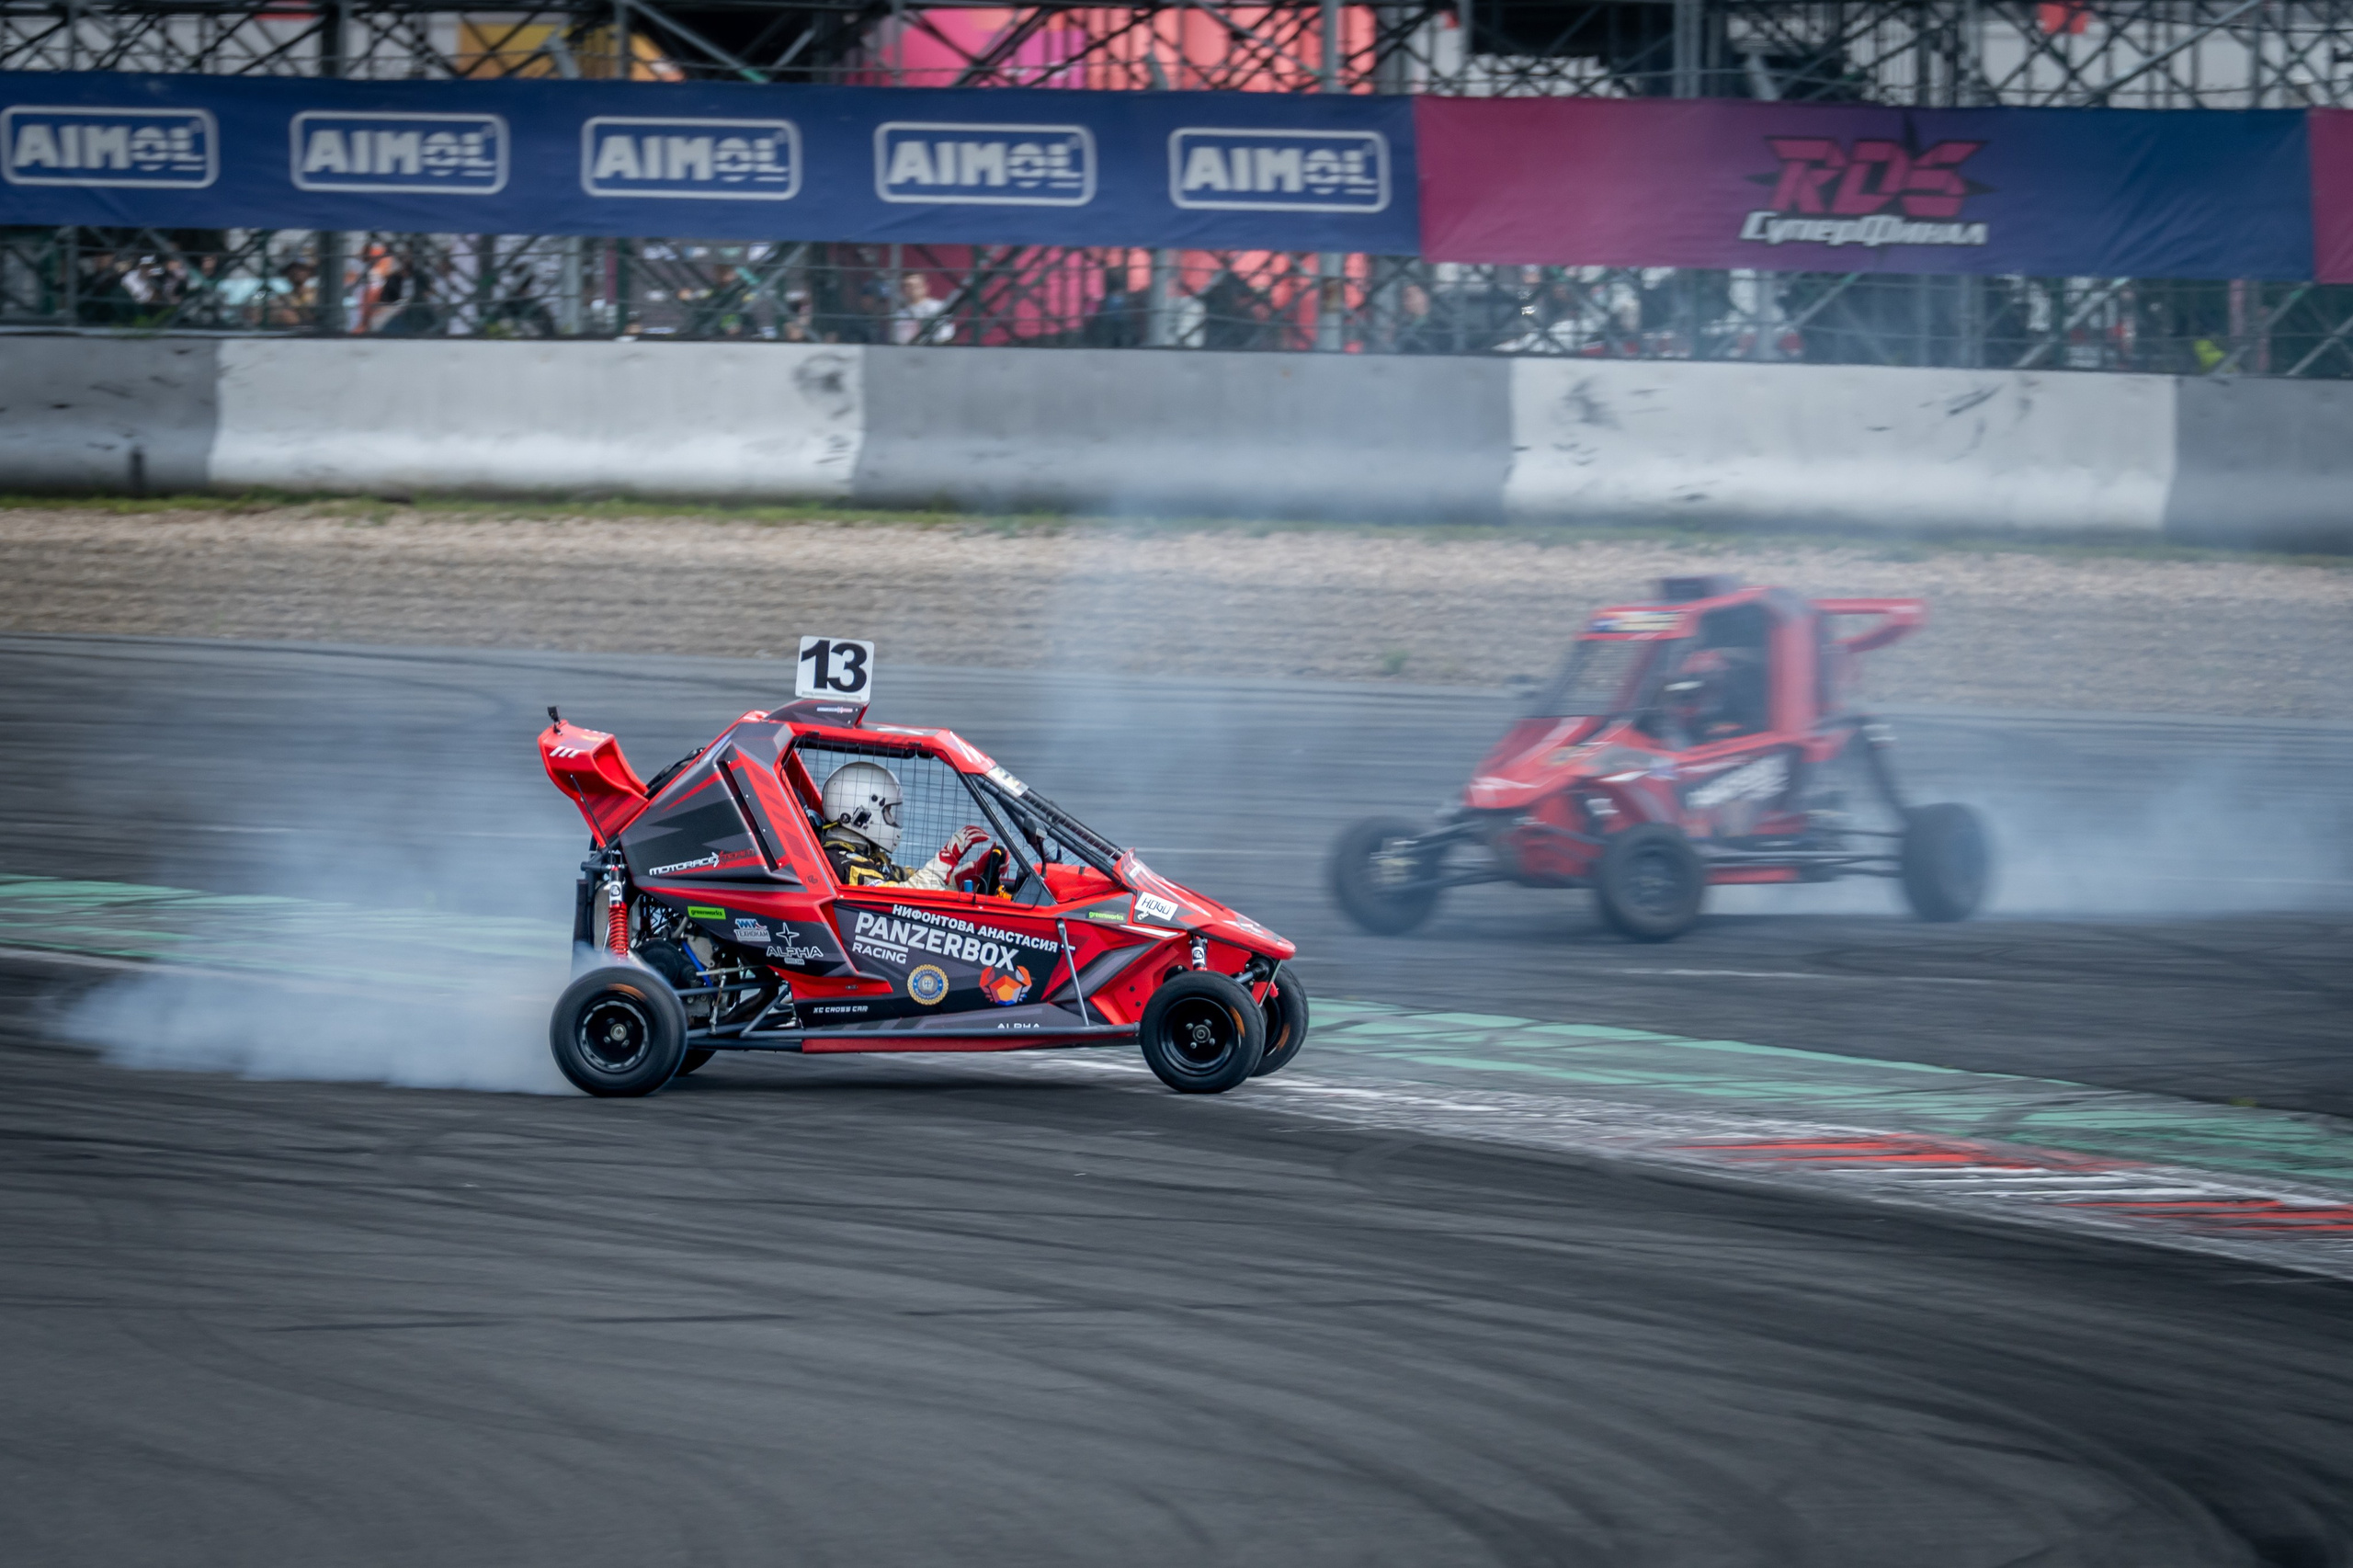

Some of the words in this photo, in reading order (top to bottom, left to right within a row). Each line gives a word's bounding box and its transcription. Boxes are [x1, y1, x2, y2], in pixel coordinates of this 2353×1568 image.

[13, 124, 206, 170] AIMOL
[301, 129, 496, 177] AIMOL
[595, 134, 789, 182] AIMOL
[888, 140, 1083, 187] AIMOL
[1182, 144, 1378, 194] AIMOL
[1767, 139, 1984, 217] RDS
[801, 640, 867, 693] 13
[690, 908, 722, 917] greenworks
[892, 903, 975, 934] НИФОНТОВА
[977, 925, 1059, 953] АНАСТАСИЯ
[1088, 911, 1124, 921] greenworks
[766, 945, 824, 959] ALPHA
[852, 941, 907, 965] RACING
[855, 911, 1019, 971] PANZERBOX
[824, 1006, 851, 1014] CROSS
[851, 1005, 869, 1013] CAR
